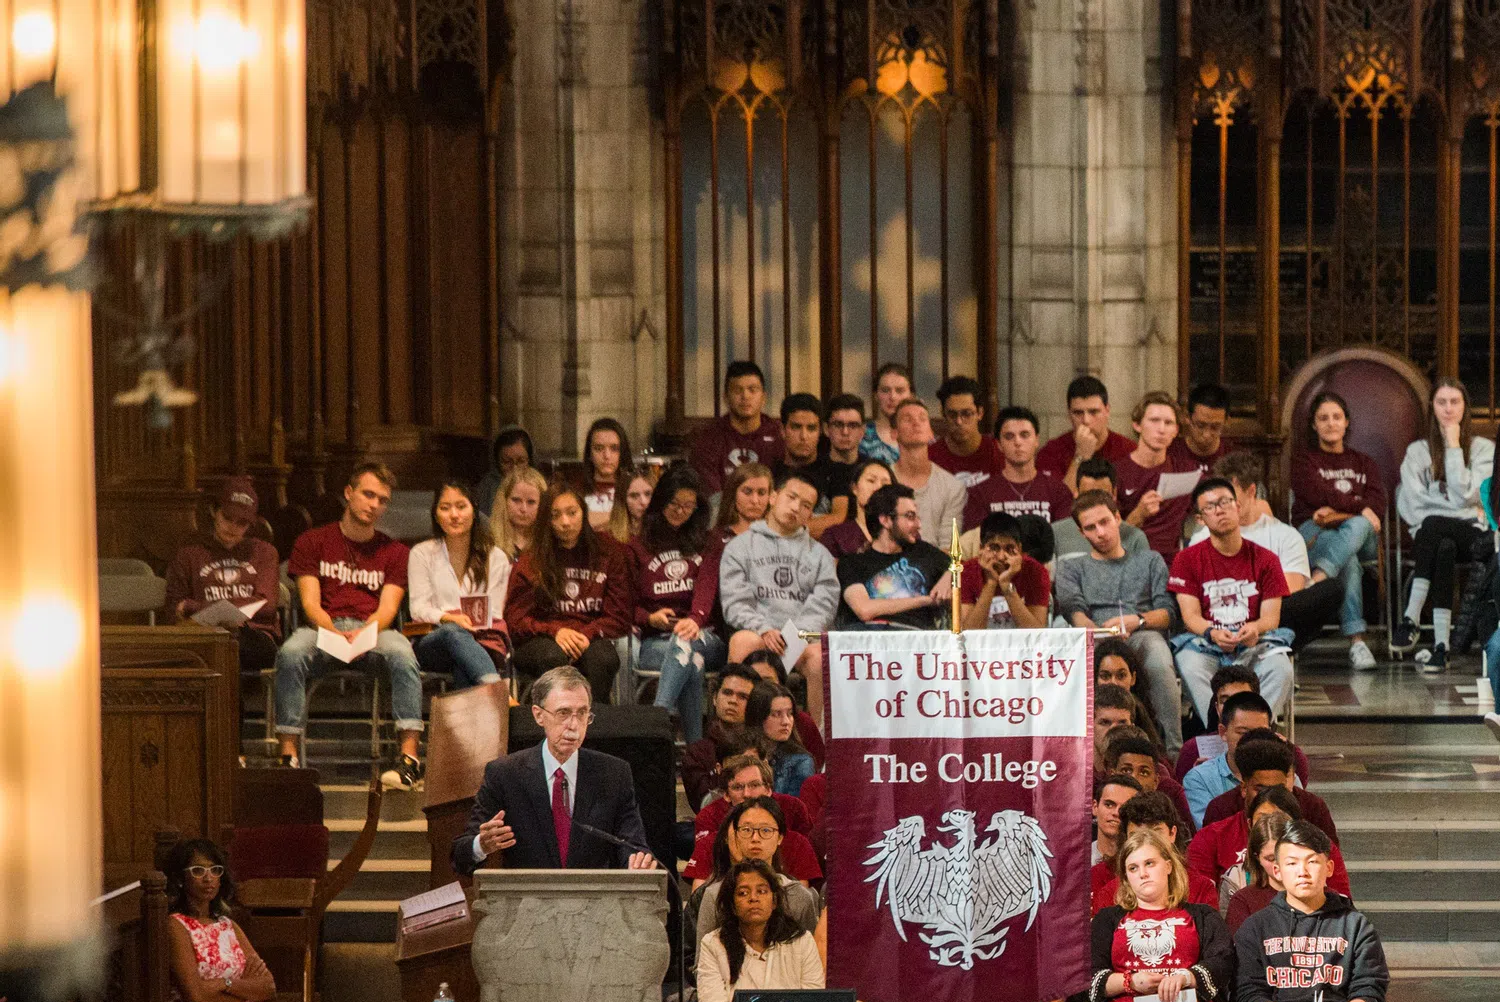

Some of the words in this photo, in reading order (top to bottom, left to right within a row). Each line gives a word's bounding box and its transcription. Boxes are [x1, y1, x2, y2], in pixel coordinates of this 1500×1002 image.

[653, 578, 694, 594] CHICAG
[757, 586, 806, 603] CHICAG
[840, 653, 903, 681] The
[914, 652, 1075, 686] University
[875, 690, 908, 718] of
[917, 689, 1044, 724] Chicago
[863, 754, 927, 783] The
[938, 753, 1057, 789] College
[1264, 937, 1282, 955] THE
[1283, 936, 1336, 953] UNIVERSITY
